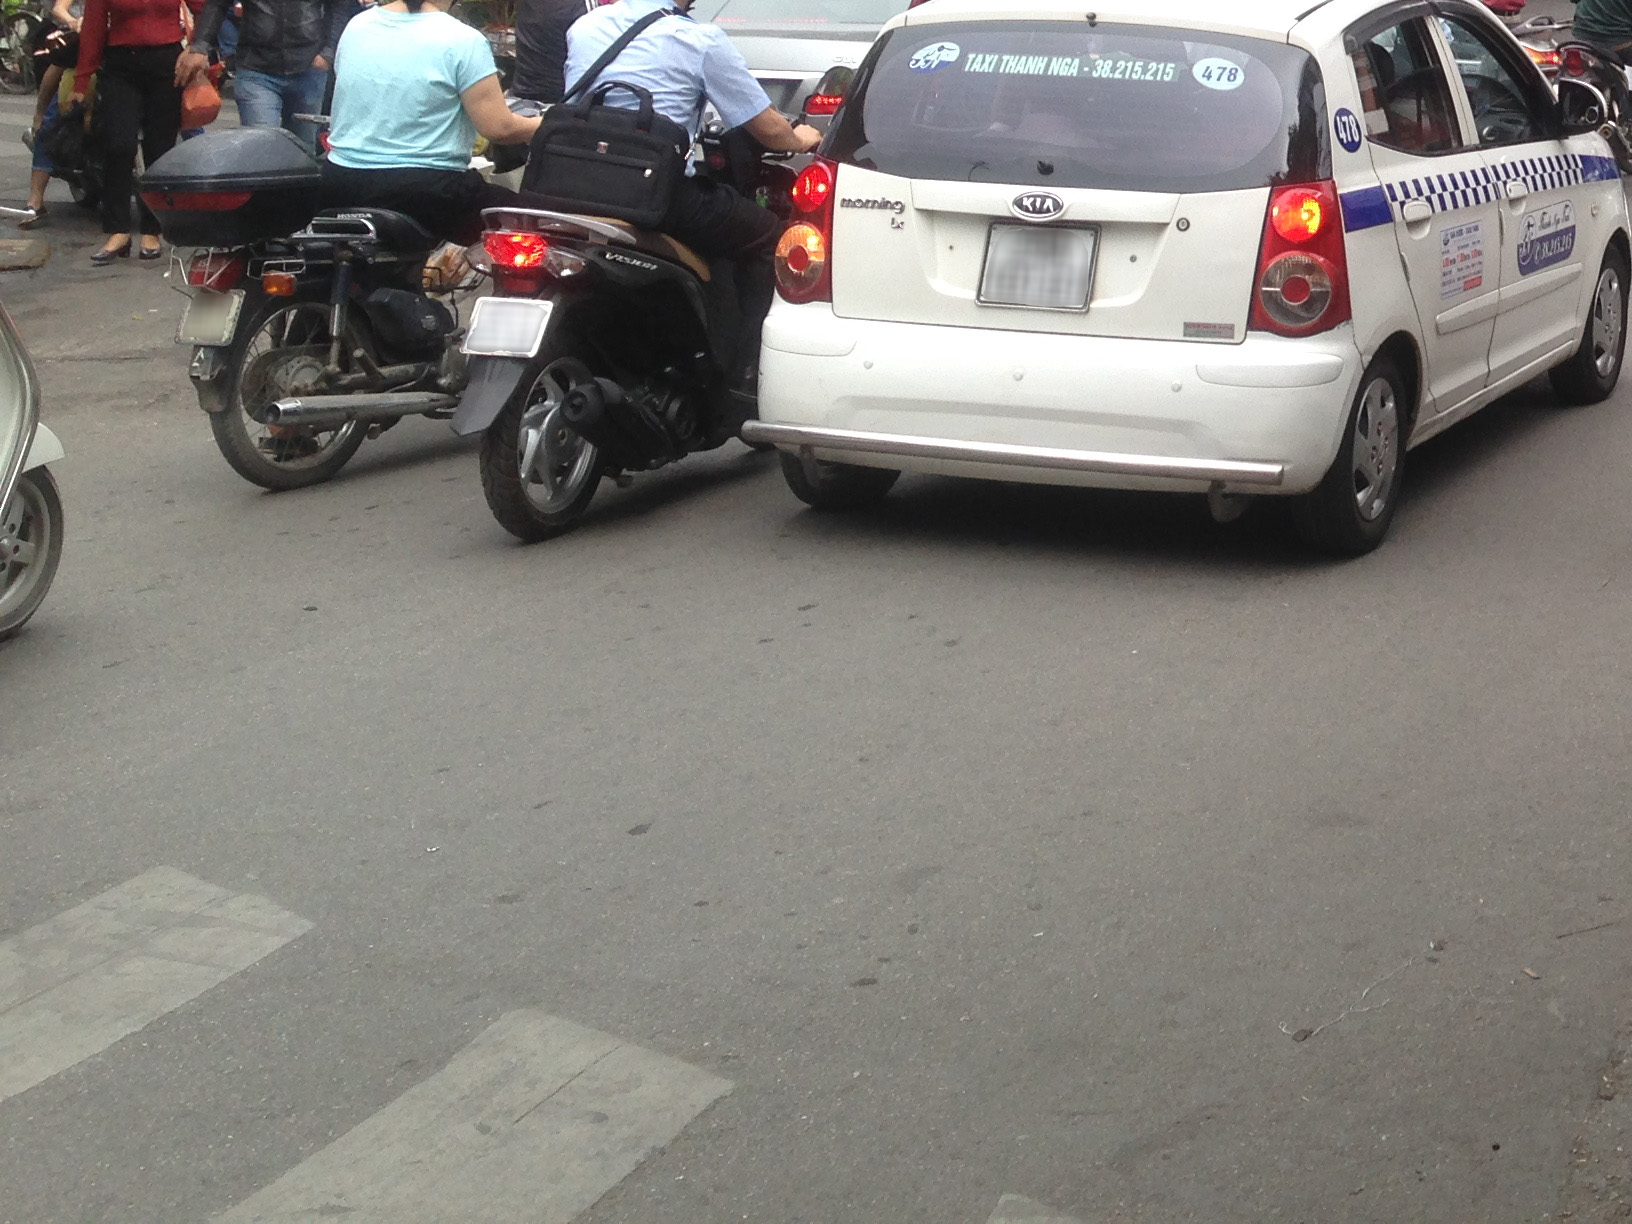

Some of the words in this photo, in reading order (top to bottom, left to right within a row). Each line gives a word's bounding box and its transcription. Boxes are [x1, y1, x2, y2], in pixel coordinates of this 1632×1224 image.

[965, 53, 996, 72] TAXI
[999, 55, 1047, 75] THANH
[1048, 57, 1078, 76] NGA
[1092, 59, 1175, 81] 38.215.215
[1201, 65, 1238, 82] 478
[1336, 115, 1360, 144] 478
[840, 197, 905, 214] morning
[1022, 197, 1055, 213] KIA
